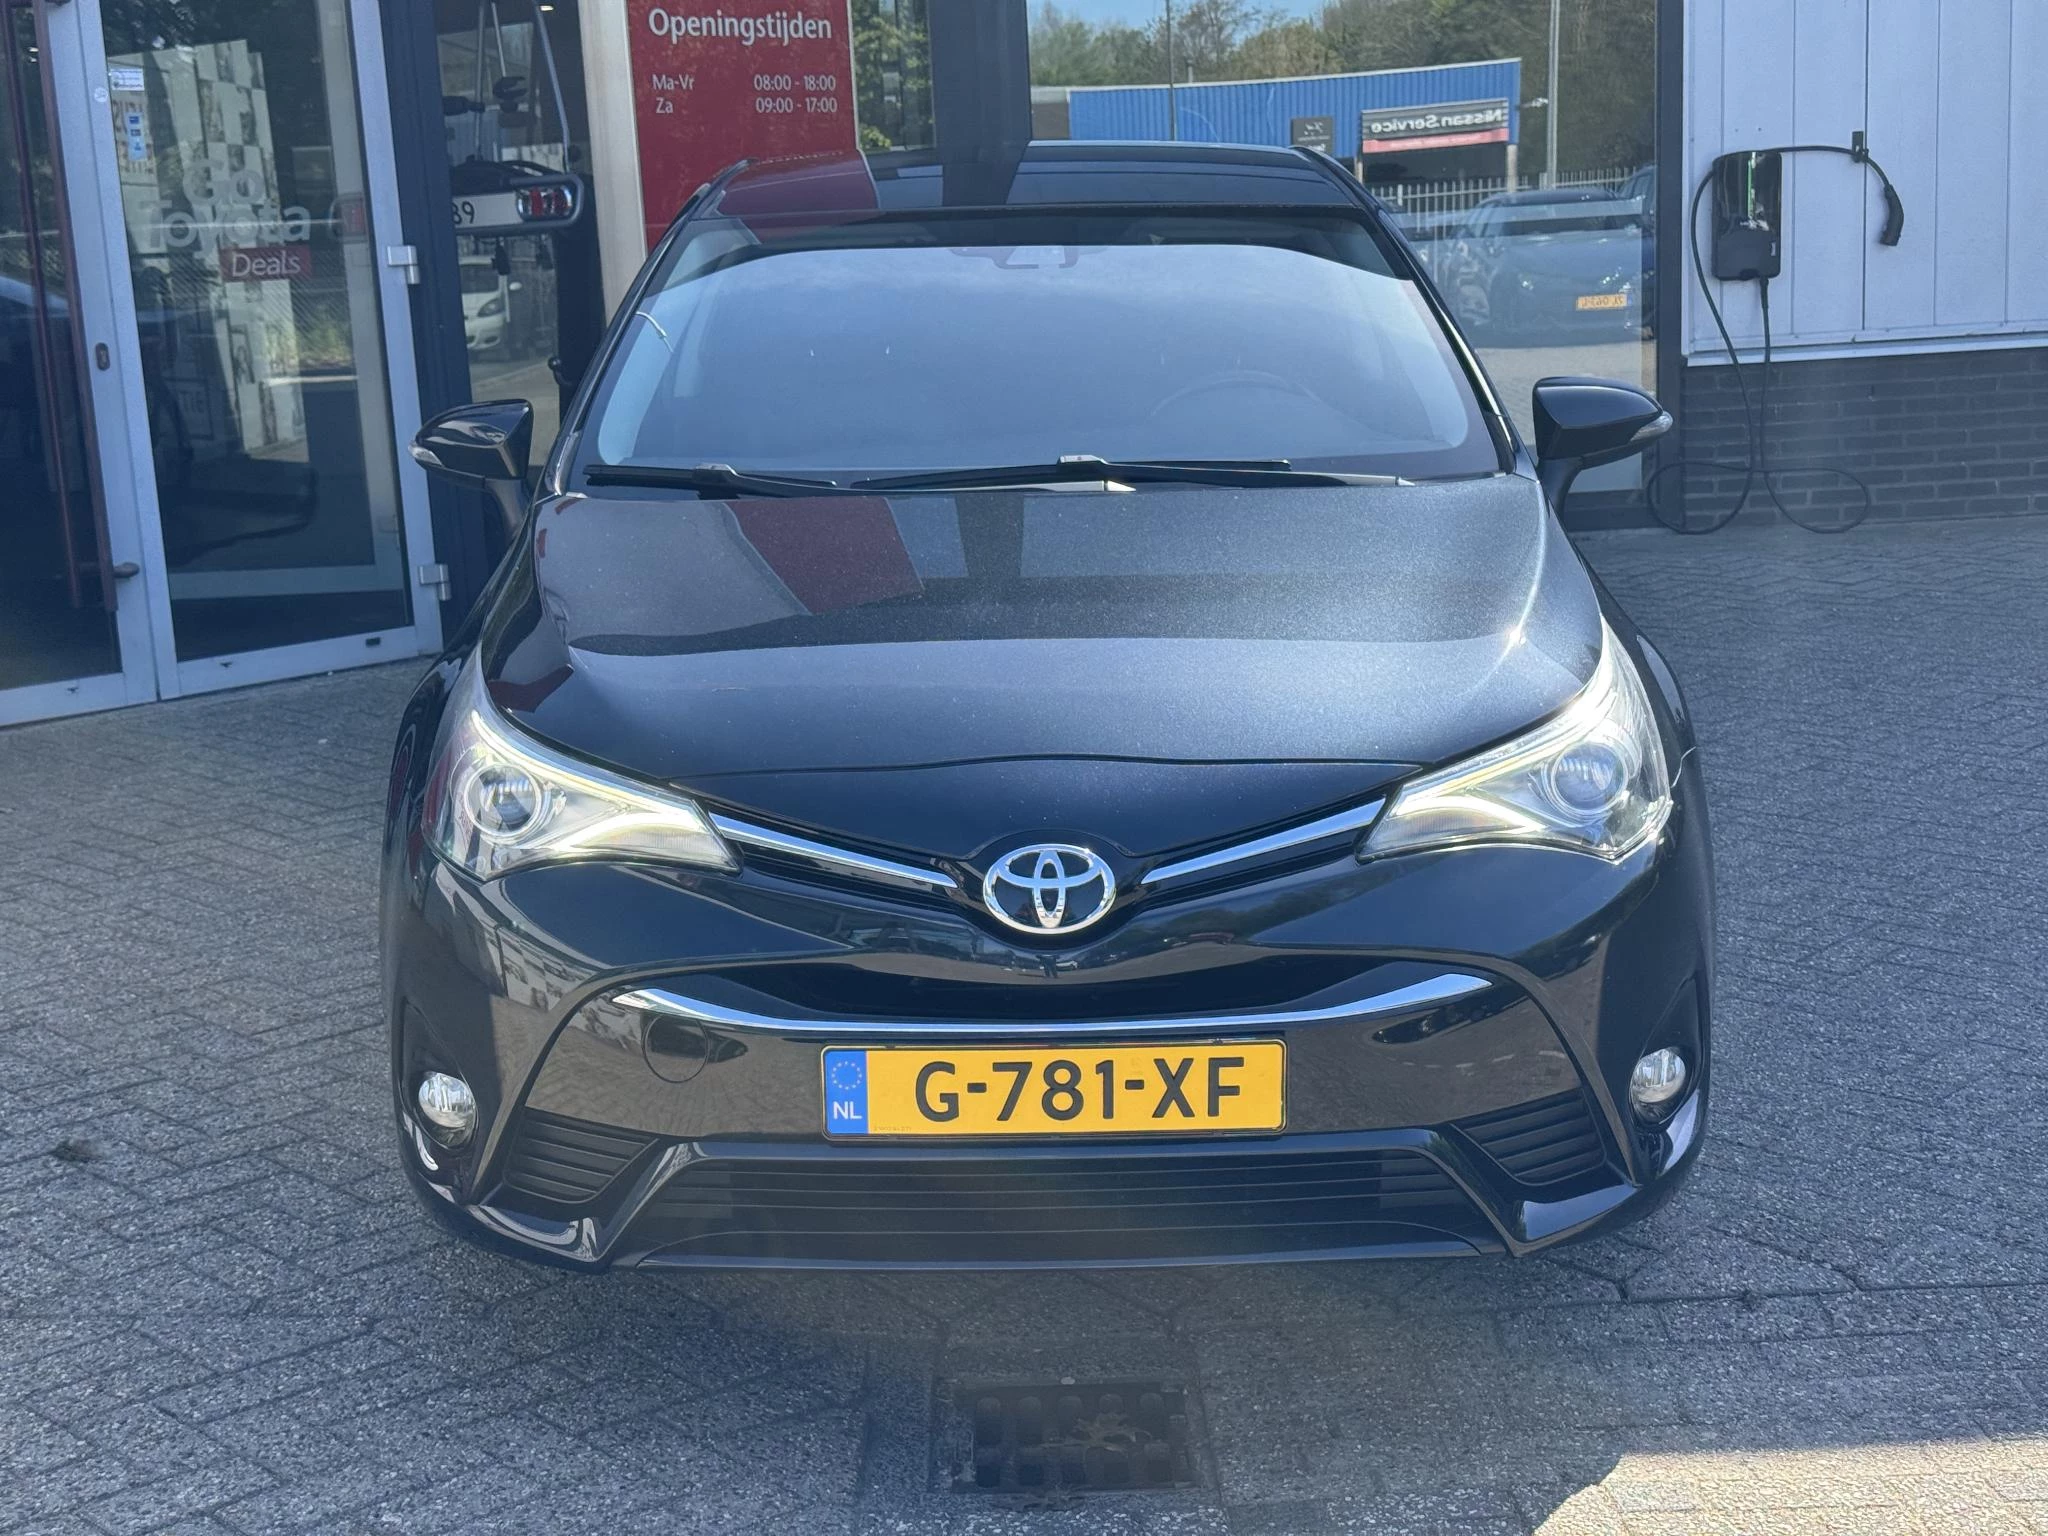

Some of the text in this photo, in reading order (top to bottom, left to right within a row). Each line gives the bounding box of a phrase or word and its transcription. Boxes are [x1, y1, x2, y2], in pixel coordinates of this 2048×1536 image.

[648, 7, 832, 46] Openingstijden
[651, 74, 695, 91] Ma-Vr
[754, 74, 792, 92] 08:00
[803, 74, 836, 91] 18:00
[655, 96, 674, 114] Za
[755, 97, 794, 114] 09:00
[805, 97, 838, 114] 17:00
[183, 158, 266, 205] Go
[139, 198, 312, 259] Toyota
[231, 250, 301, 278] Deals
[914, 1056, 1246, 1123] G-781-XF
[832, 1100, 863, 1121] NL
